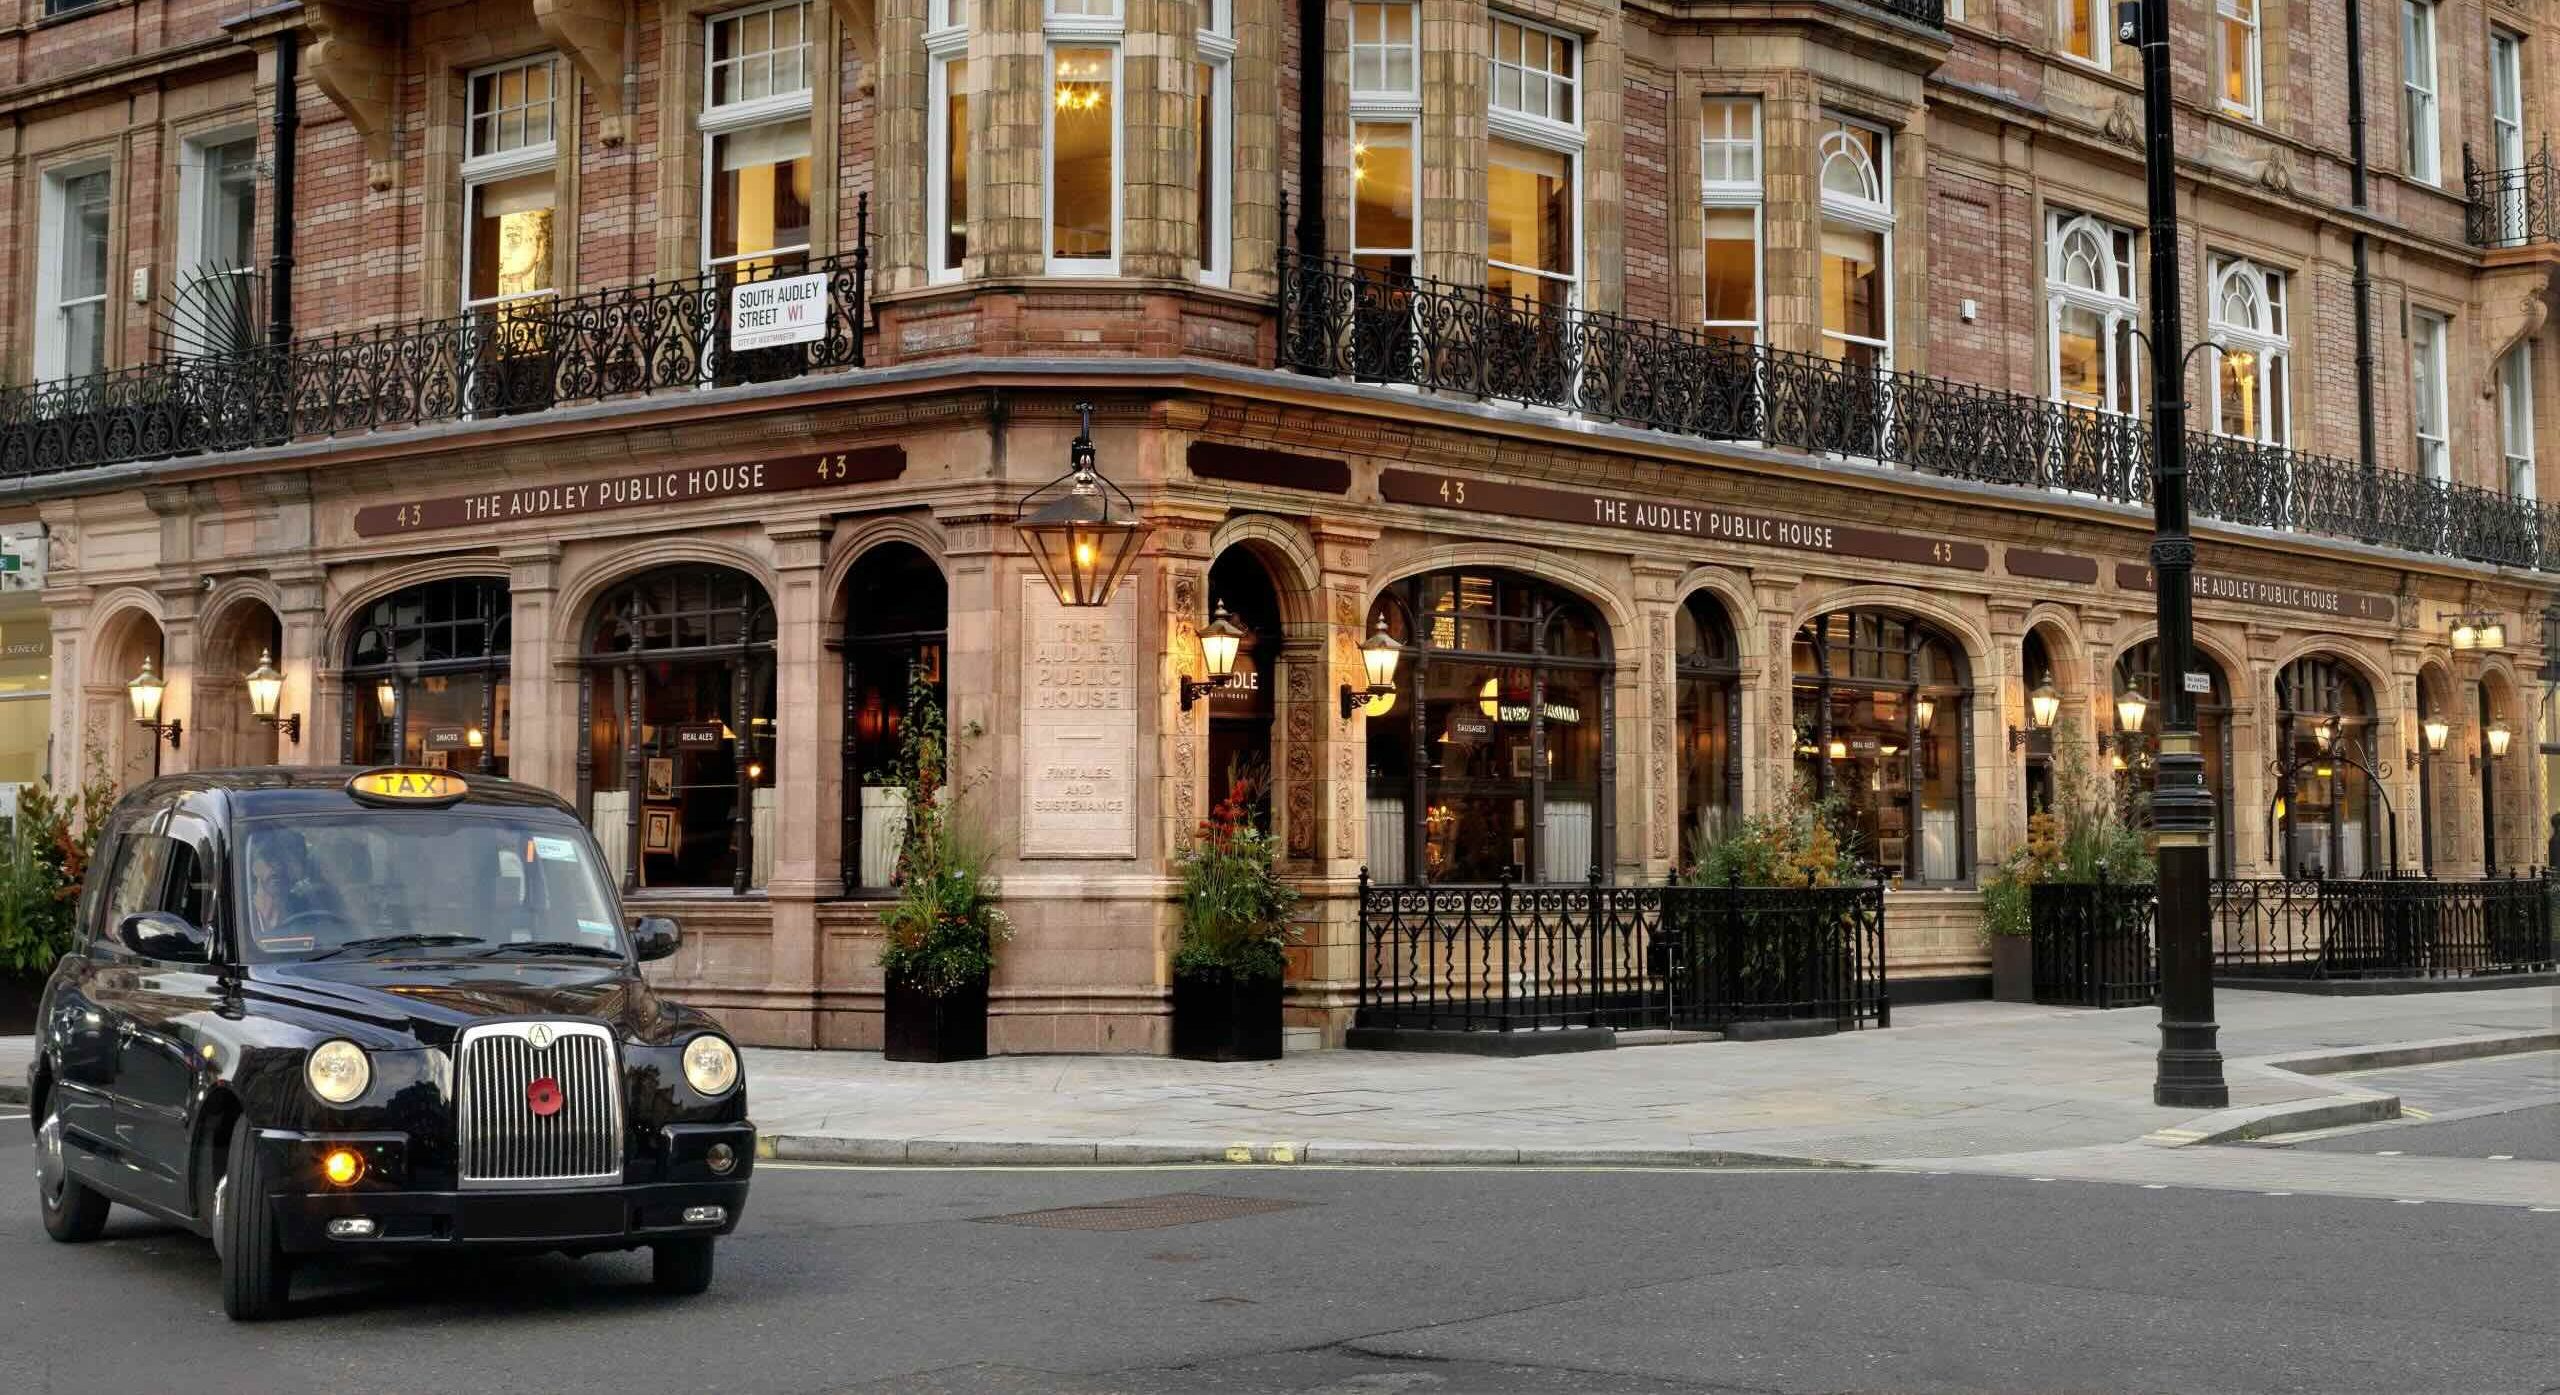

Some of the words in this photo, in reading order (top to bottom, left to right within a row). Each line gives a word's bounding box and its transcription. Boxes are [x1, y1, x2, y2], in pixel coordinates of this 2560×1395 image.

[739, 289, 774, 309] SOUTH
[778, 281, 819, 303] AUDLEY
[739, 308, 778, 328] STREET
[788, 303, 804, 322] W1
[397, 503, 422, 527] 43
[465, 496, 501, 521] THE
[510, 485, 589, 516] AUDLEY
[600, 474, 678, 505] PUBLIC
[688, 464, 764, 495] HOUSE
[817, 455, 847, 480] 43
[1440, 480, 1465, 504] 43
[1594, 499, 1628, 524] THE
[1635, 504, 1702, 533] AUDLEY
[1711, 513, 1772, 541] PUBLIC
[1780, 524, 1833, 549] HOUSE
[1933, 542, 1952, 563] 43
[2193, 576, 2208, 595] HE
[2212, 579, 2256, 600] AUDLEY
[2260, 584, 2299, 606] PUBLIC
[2303, 590, 2339, 611] HOUSE
[1056, 622, 1103, 643] THE
[1036, 644, 1125, 663] AUDLEY
[1039, 667, 1121, 686] PUBLIC
[1040, 688, 1119, 709] HOUSE
[682, 733, 697, 741] REAL
[699, 733, 713, 741] ALES
[380, 776, 448, 794] TAXI
